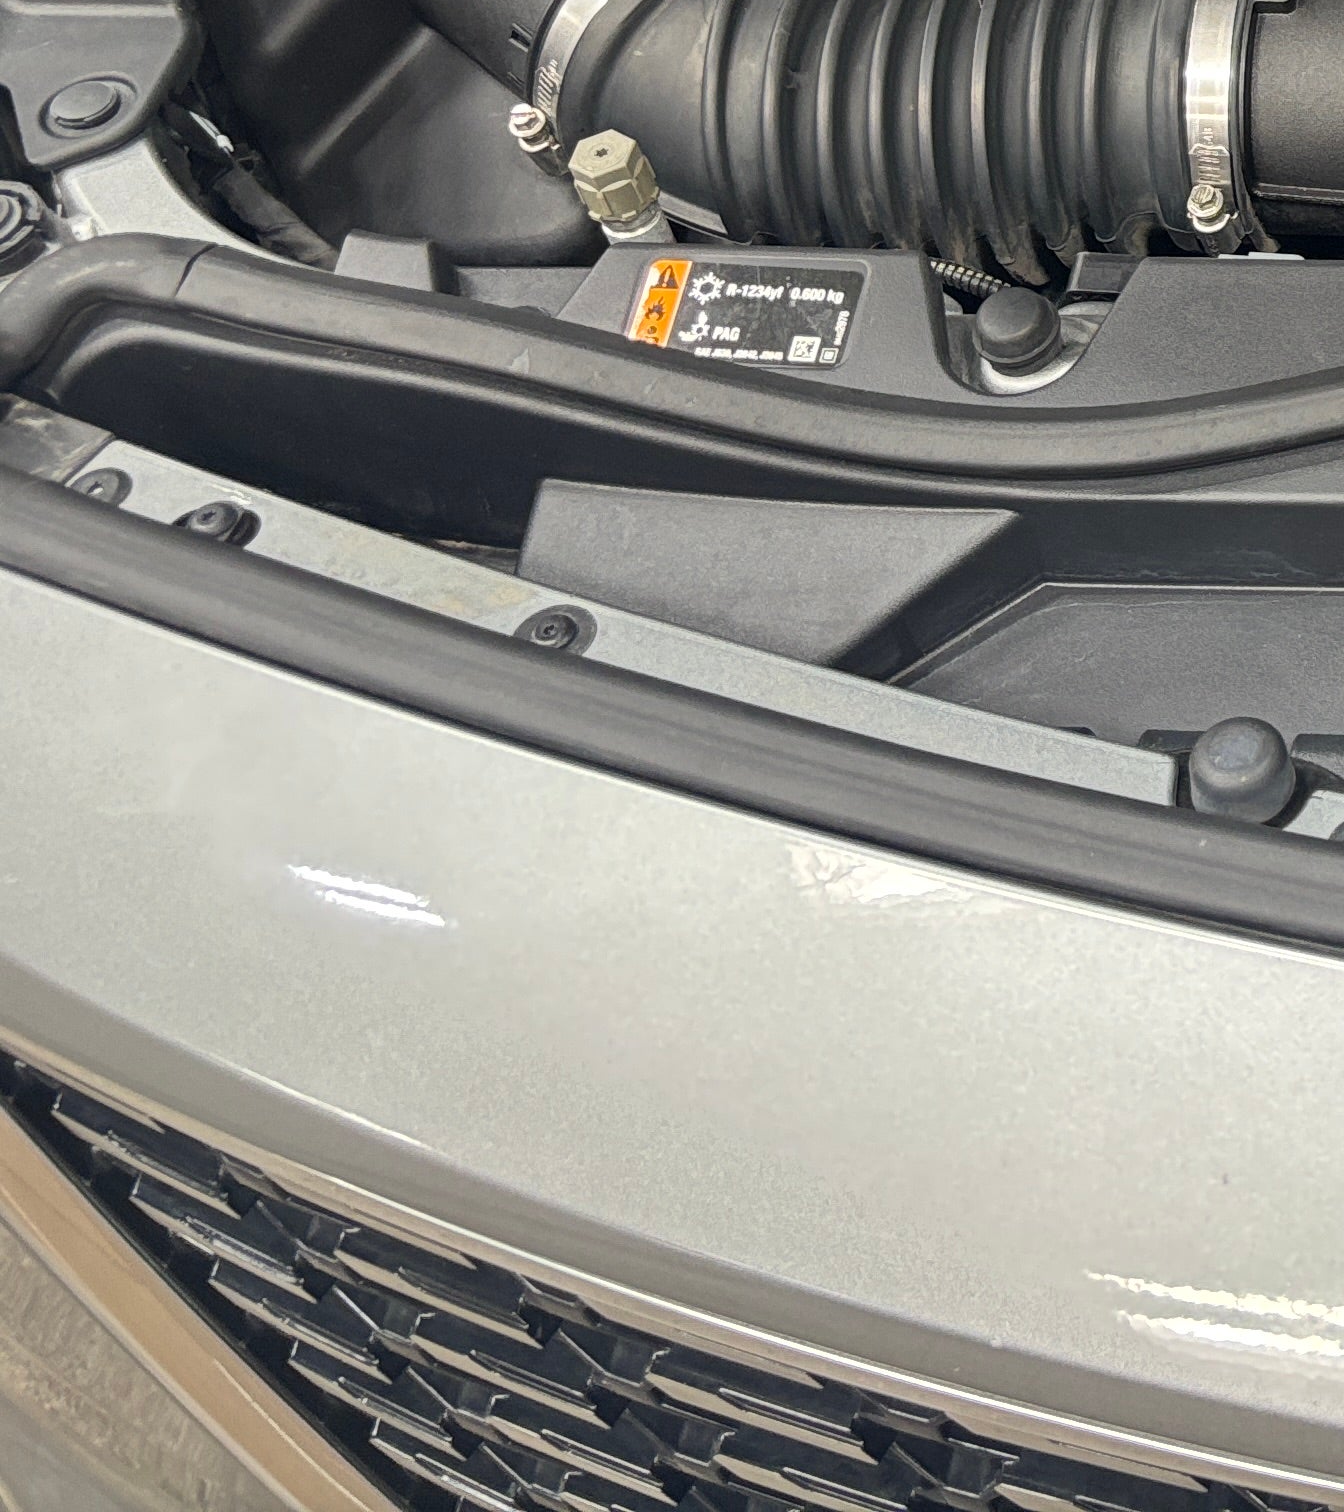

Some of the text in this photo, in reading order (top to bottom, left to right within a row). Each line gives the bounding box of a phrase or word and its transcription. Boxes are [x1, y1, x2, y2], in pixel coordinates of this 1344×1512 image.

[726, 283, 845, 305] R-1234yf 0.600 kg
[712, 326, 741, 341] PAG
